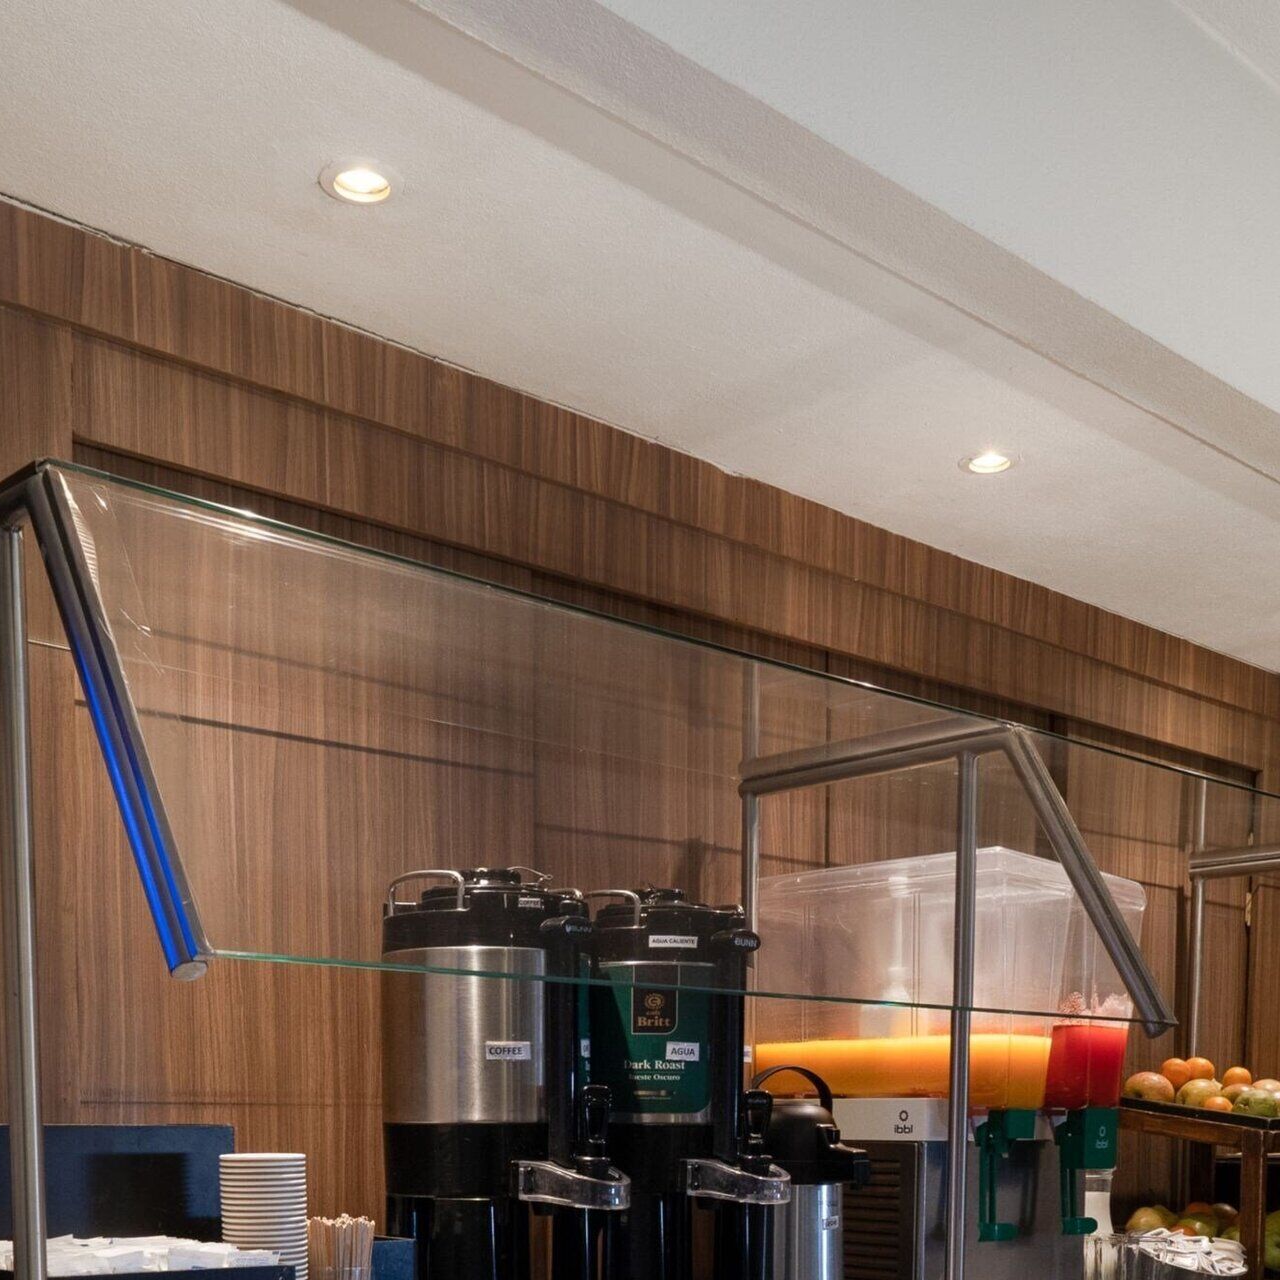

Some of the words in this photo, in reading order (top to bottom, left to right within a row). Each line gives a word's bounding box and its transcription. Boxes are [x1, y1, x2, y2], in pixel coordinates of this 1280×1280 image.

[637, 1016, 671, 1027] Britt
[489, 1046, 523, 1055] COFFEE
[671, 1047, 696, 1056] AGUA
[624, 1059, 652, 1070] Dark
[654, 1060, 686, 1070] Roast
[629, 1073, 652, 1081] ueste
[653, 1073, 681, 1081] Oscuro
[894, 1124, 913, 1134] ibbl
